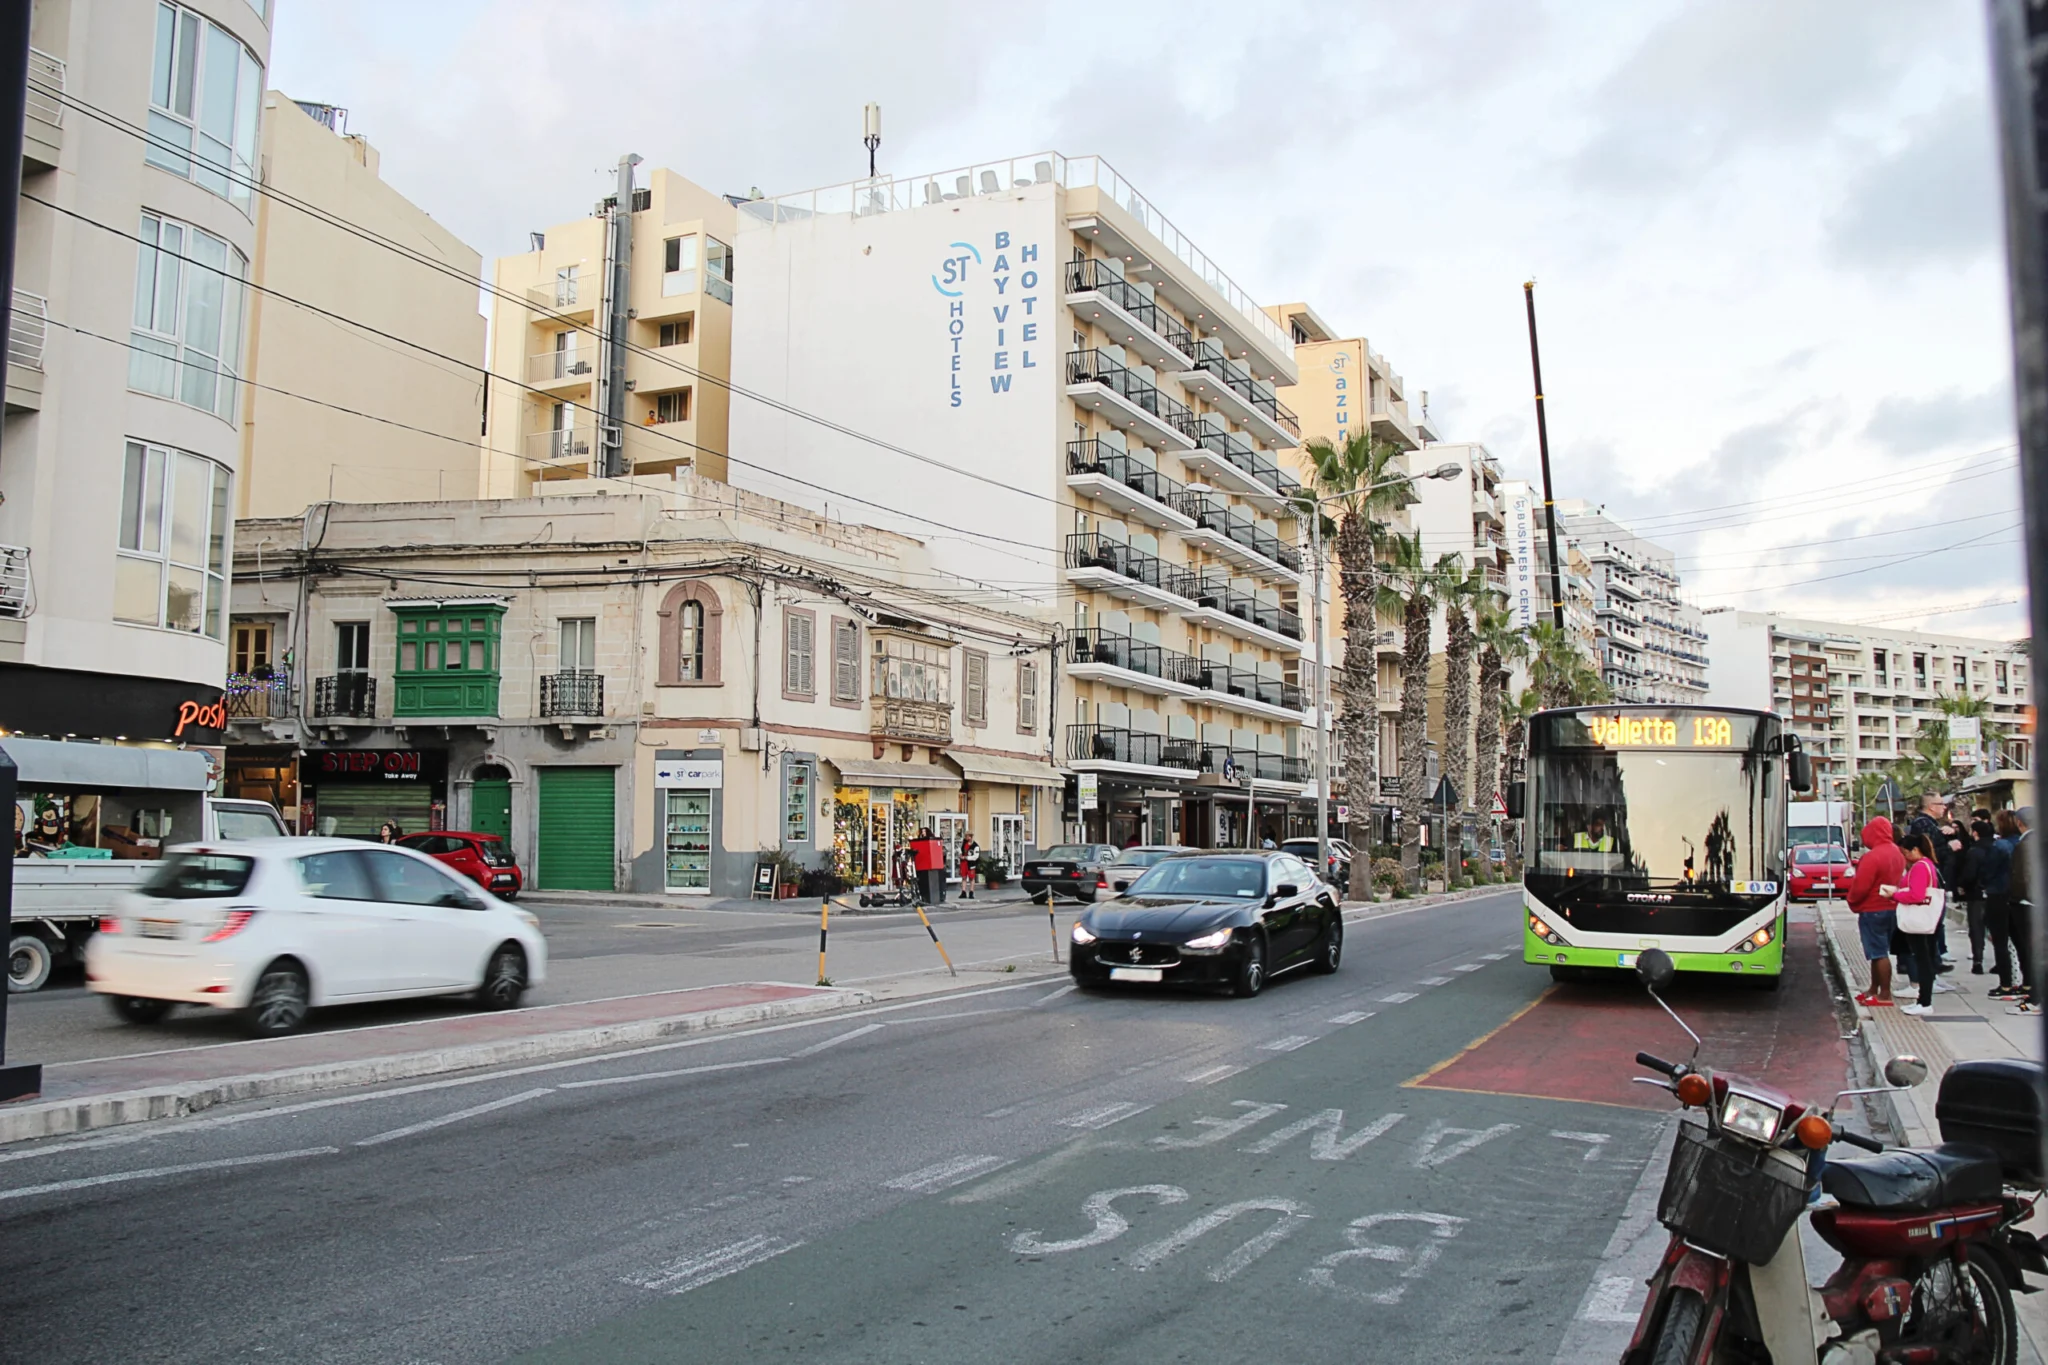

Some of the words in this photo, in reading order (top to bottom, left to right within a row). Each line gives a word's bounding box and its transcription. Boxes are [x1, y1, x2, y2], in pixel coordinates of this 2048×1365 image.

[943, 255, 971, 284] ST
[993, 231, 1010, 294] BAY
[1021, 244, 1038, 368] HOTEL
[949, 301, 964, 407] HOTELS
[990, 305, 1012, 393] VIEW
[1333, 358, 1346, 369] ST
[1335, 377, 1347, 441] azur
[1515, 500, 1525, 509] ST
[1517, 513, 1528, 582] BUSINESS
[174, 695, 226, 736] Posh
[1592, 716, 1677, 745] Valletta
[1693, 716, 1732, 745] 13A
[322, 752, 380, 772] STEP
[384, 752, 420, 772] ON
[676, 770, 684, 778] ST
[687, 769, 720, 780] carpark
[1627, 893, 1672, 903] OTOKAR
[1145, 1099, 1613, 1168] LANE
[1002, 1183, 1471, 1305] BUS
